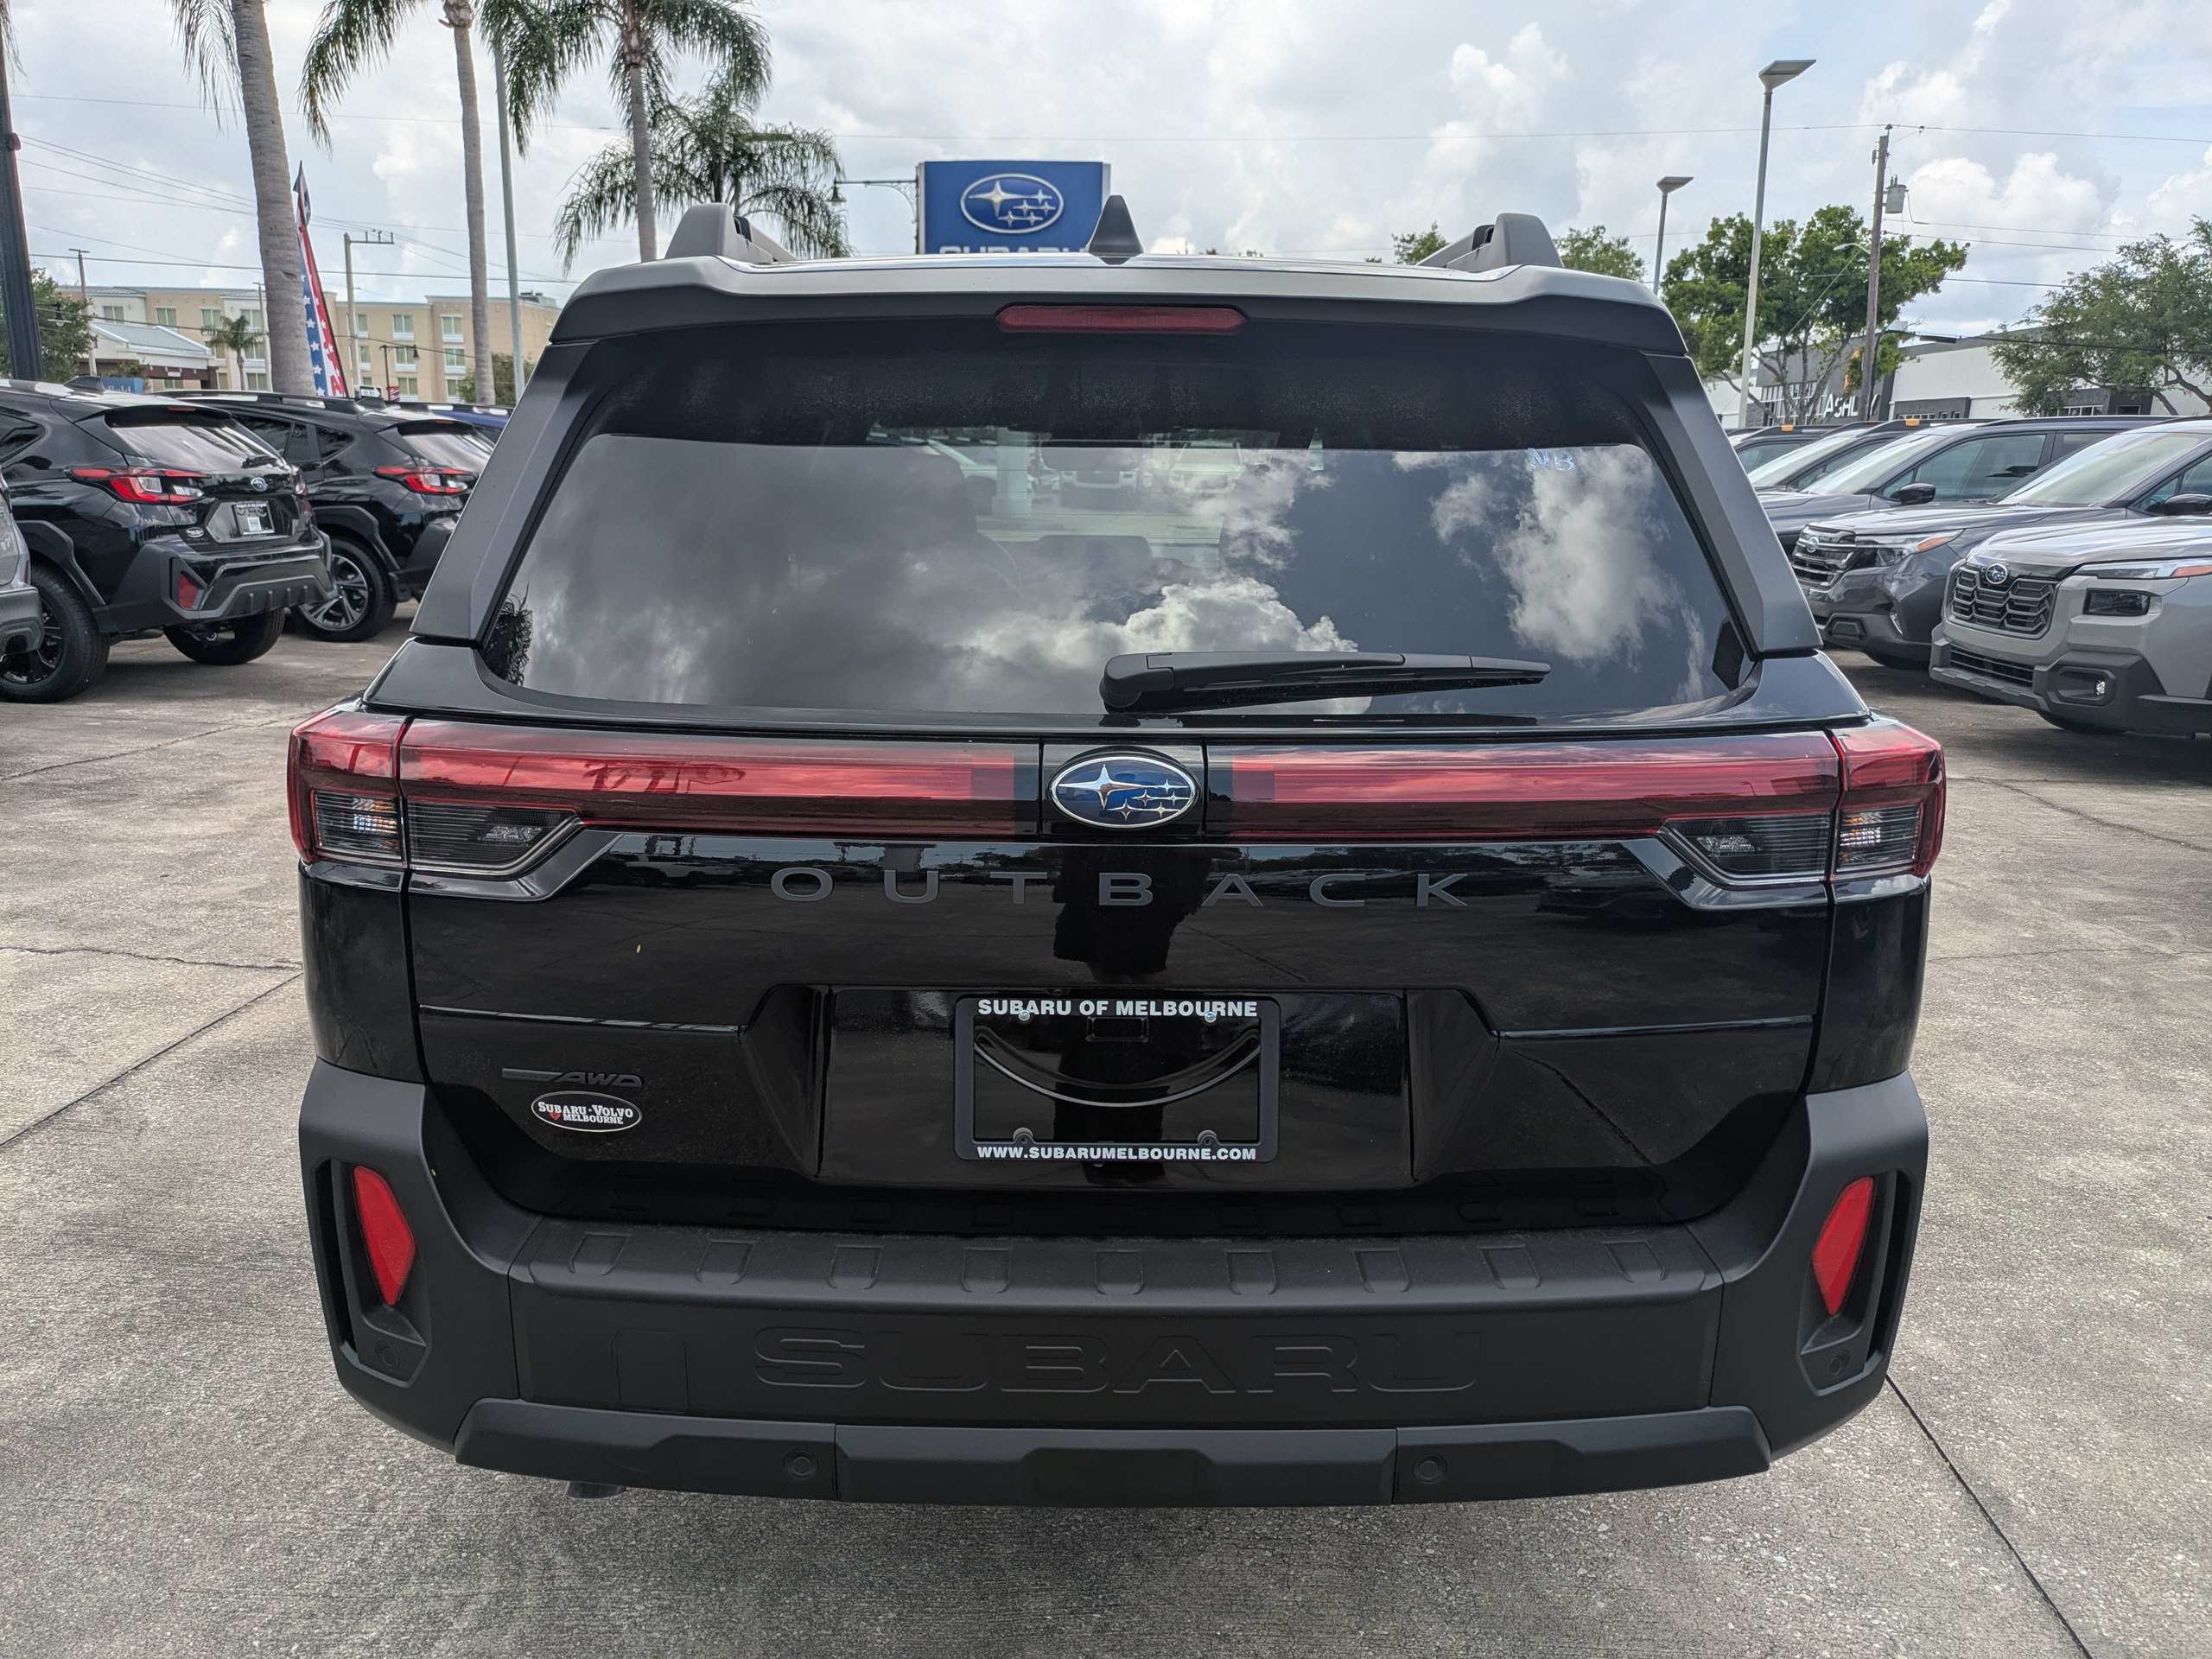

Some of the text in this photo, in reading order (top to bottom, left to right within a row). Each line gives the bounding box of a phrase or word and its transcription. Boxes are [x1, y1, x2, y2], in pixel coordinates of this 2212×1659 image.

[1822, 393, 1878, 417] ASHLY
[771, 867, 1469, 908] OUTBACK
[977, 999, 1258, 1018] SUBARU OF MELBOURNE
[556, 1071, 643, 1087] AWD
[563, 1113, 624, 1125] MELBOURNE
[977, 1146, 1257, 1160] WWW.SUBARUMELBOURNE.COM
[753, 1325, 1484, 1394] SUBARU
